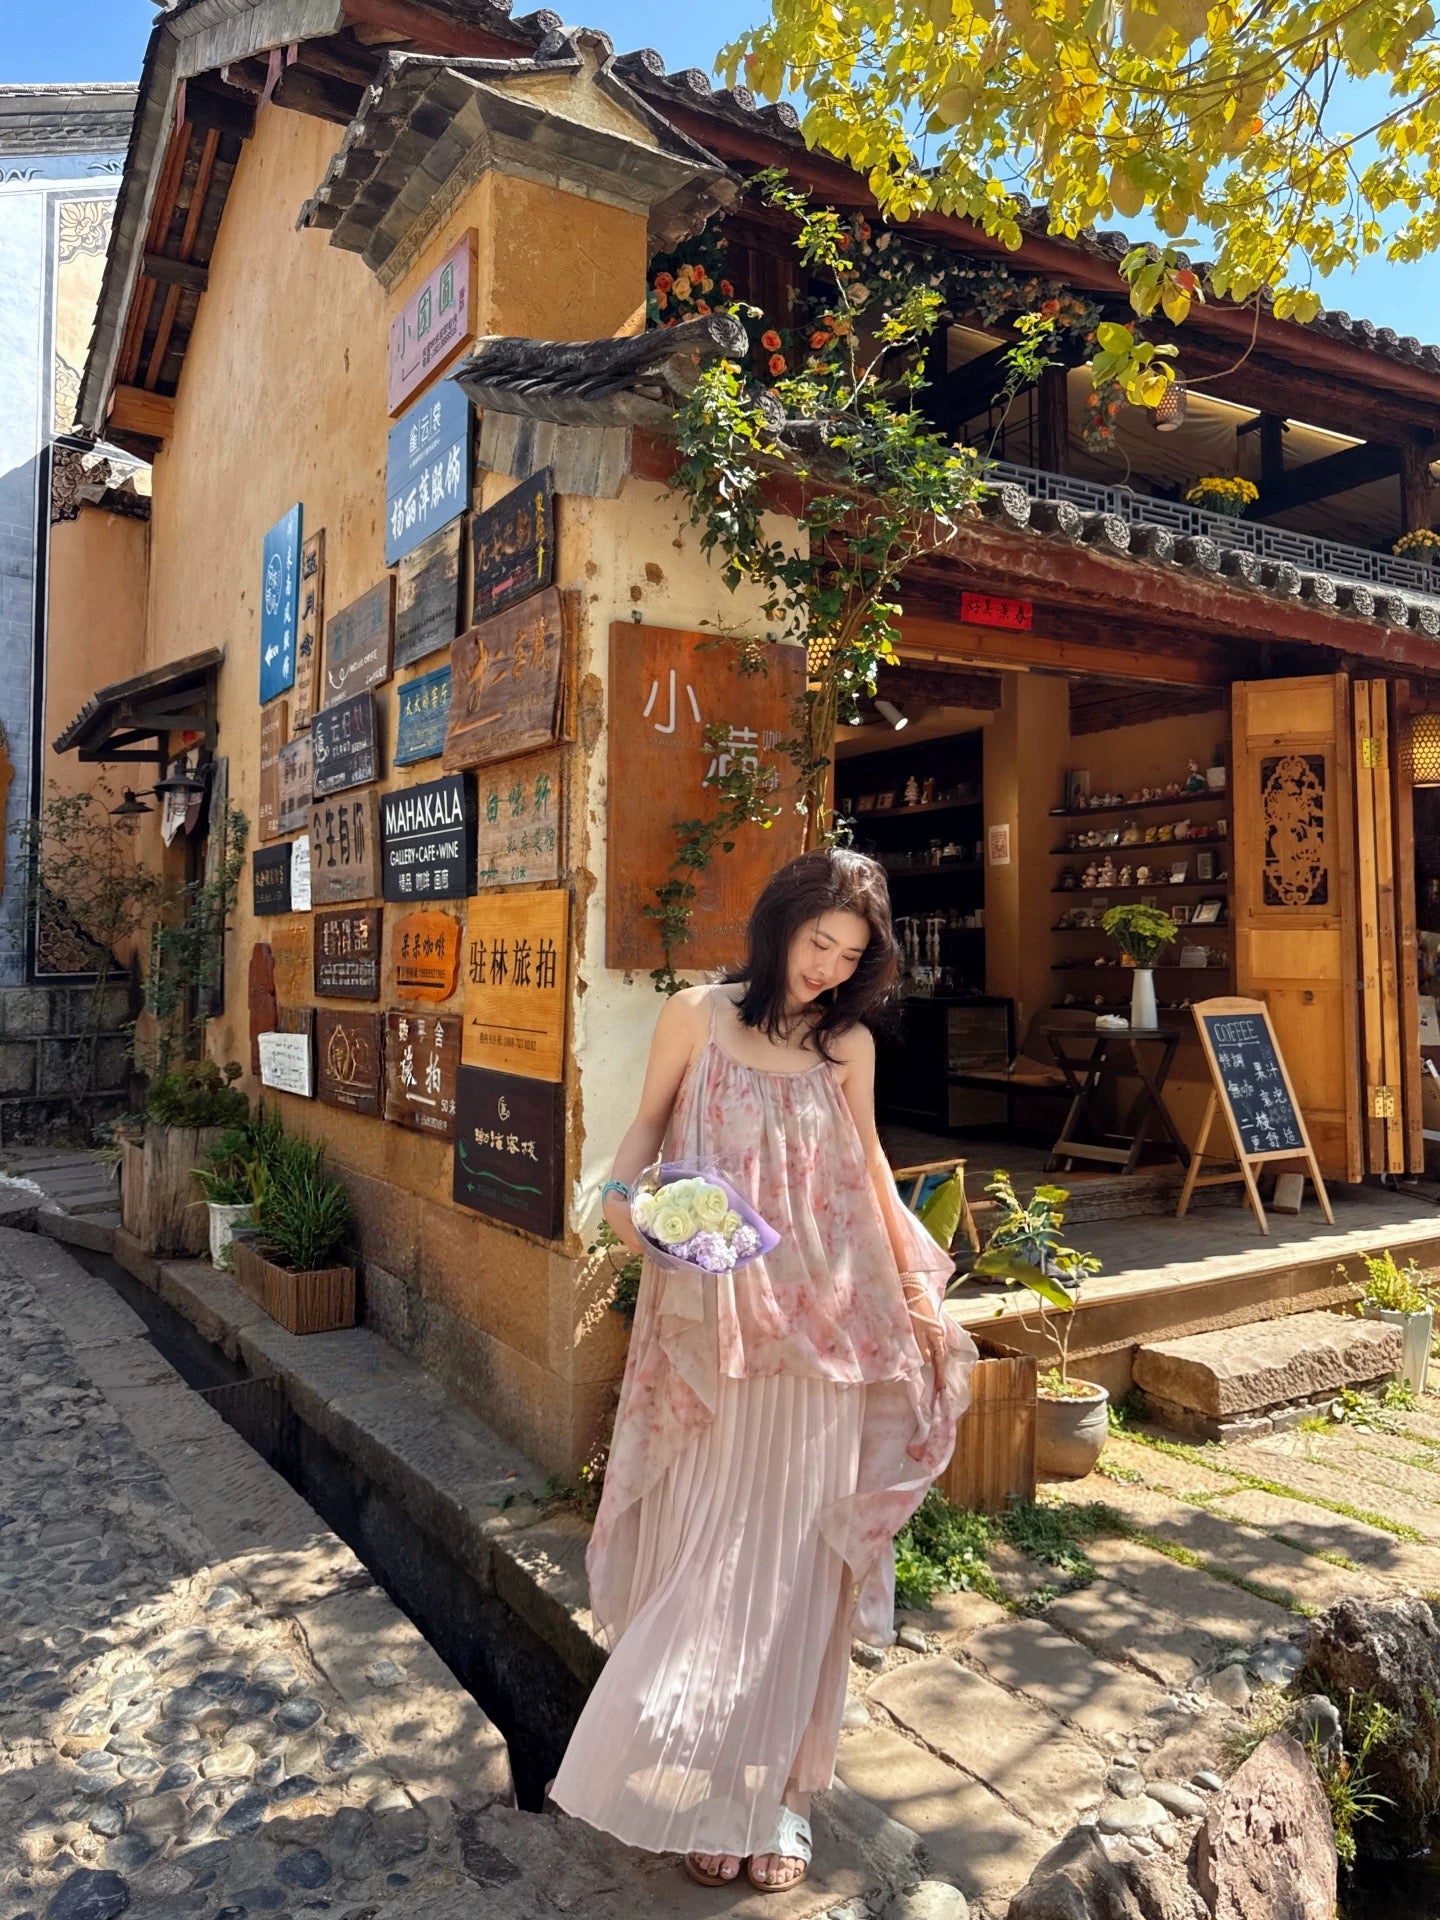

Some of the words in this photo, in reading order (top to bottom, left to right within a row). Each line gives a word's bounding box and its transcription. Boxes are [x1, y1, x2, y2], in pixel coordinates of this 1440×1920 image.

[391, 444, 461, 541] 杨丽萍服饰
[386, 787, 463, 835] MAHAKALA
[313, 802, 365, 869] 今生有你
[416, 870, 430, 891] 咖啡
[510, 866, 527, 881] 20米
[401, 932, 445, 959] 呆呆咖啡
[469, 938, 557, 989] 驻林旅拍
[1213, 1020, 1258, 1042] COFFEE
[1253, 1061, 1279, 1082] 果汁
[441, 1099, 456, 1115] 50米
